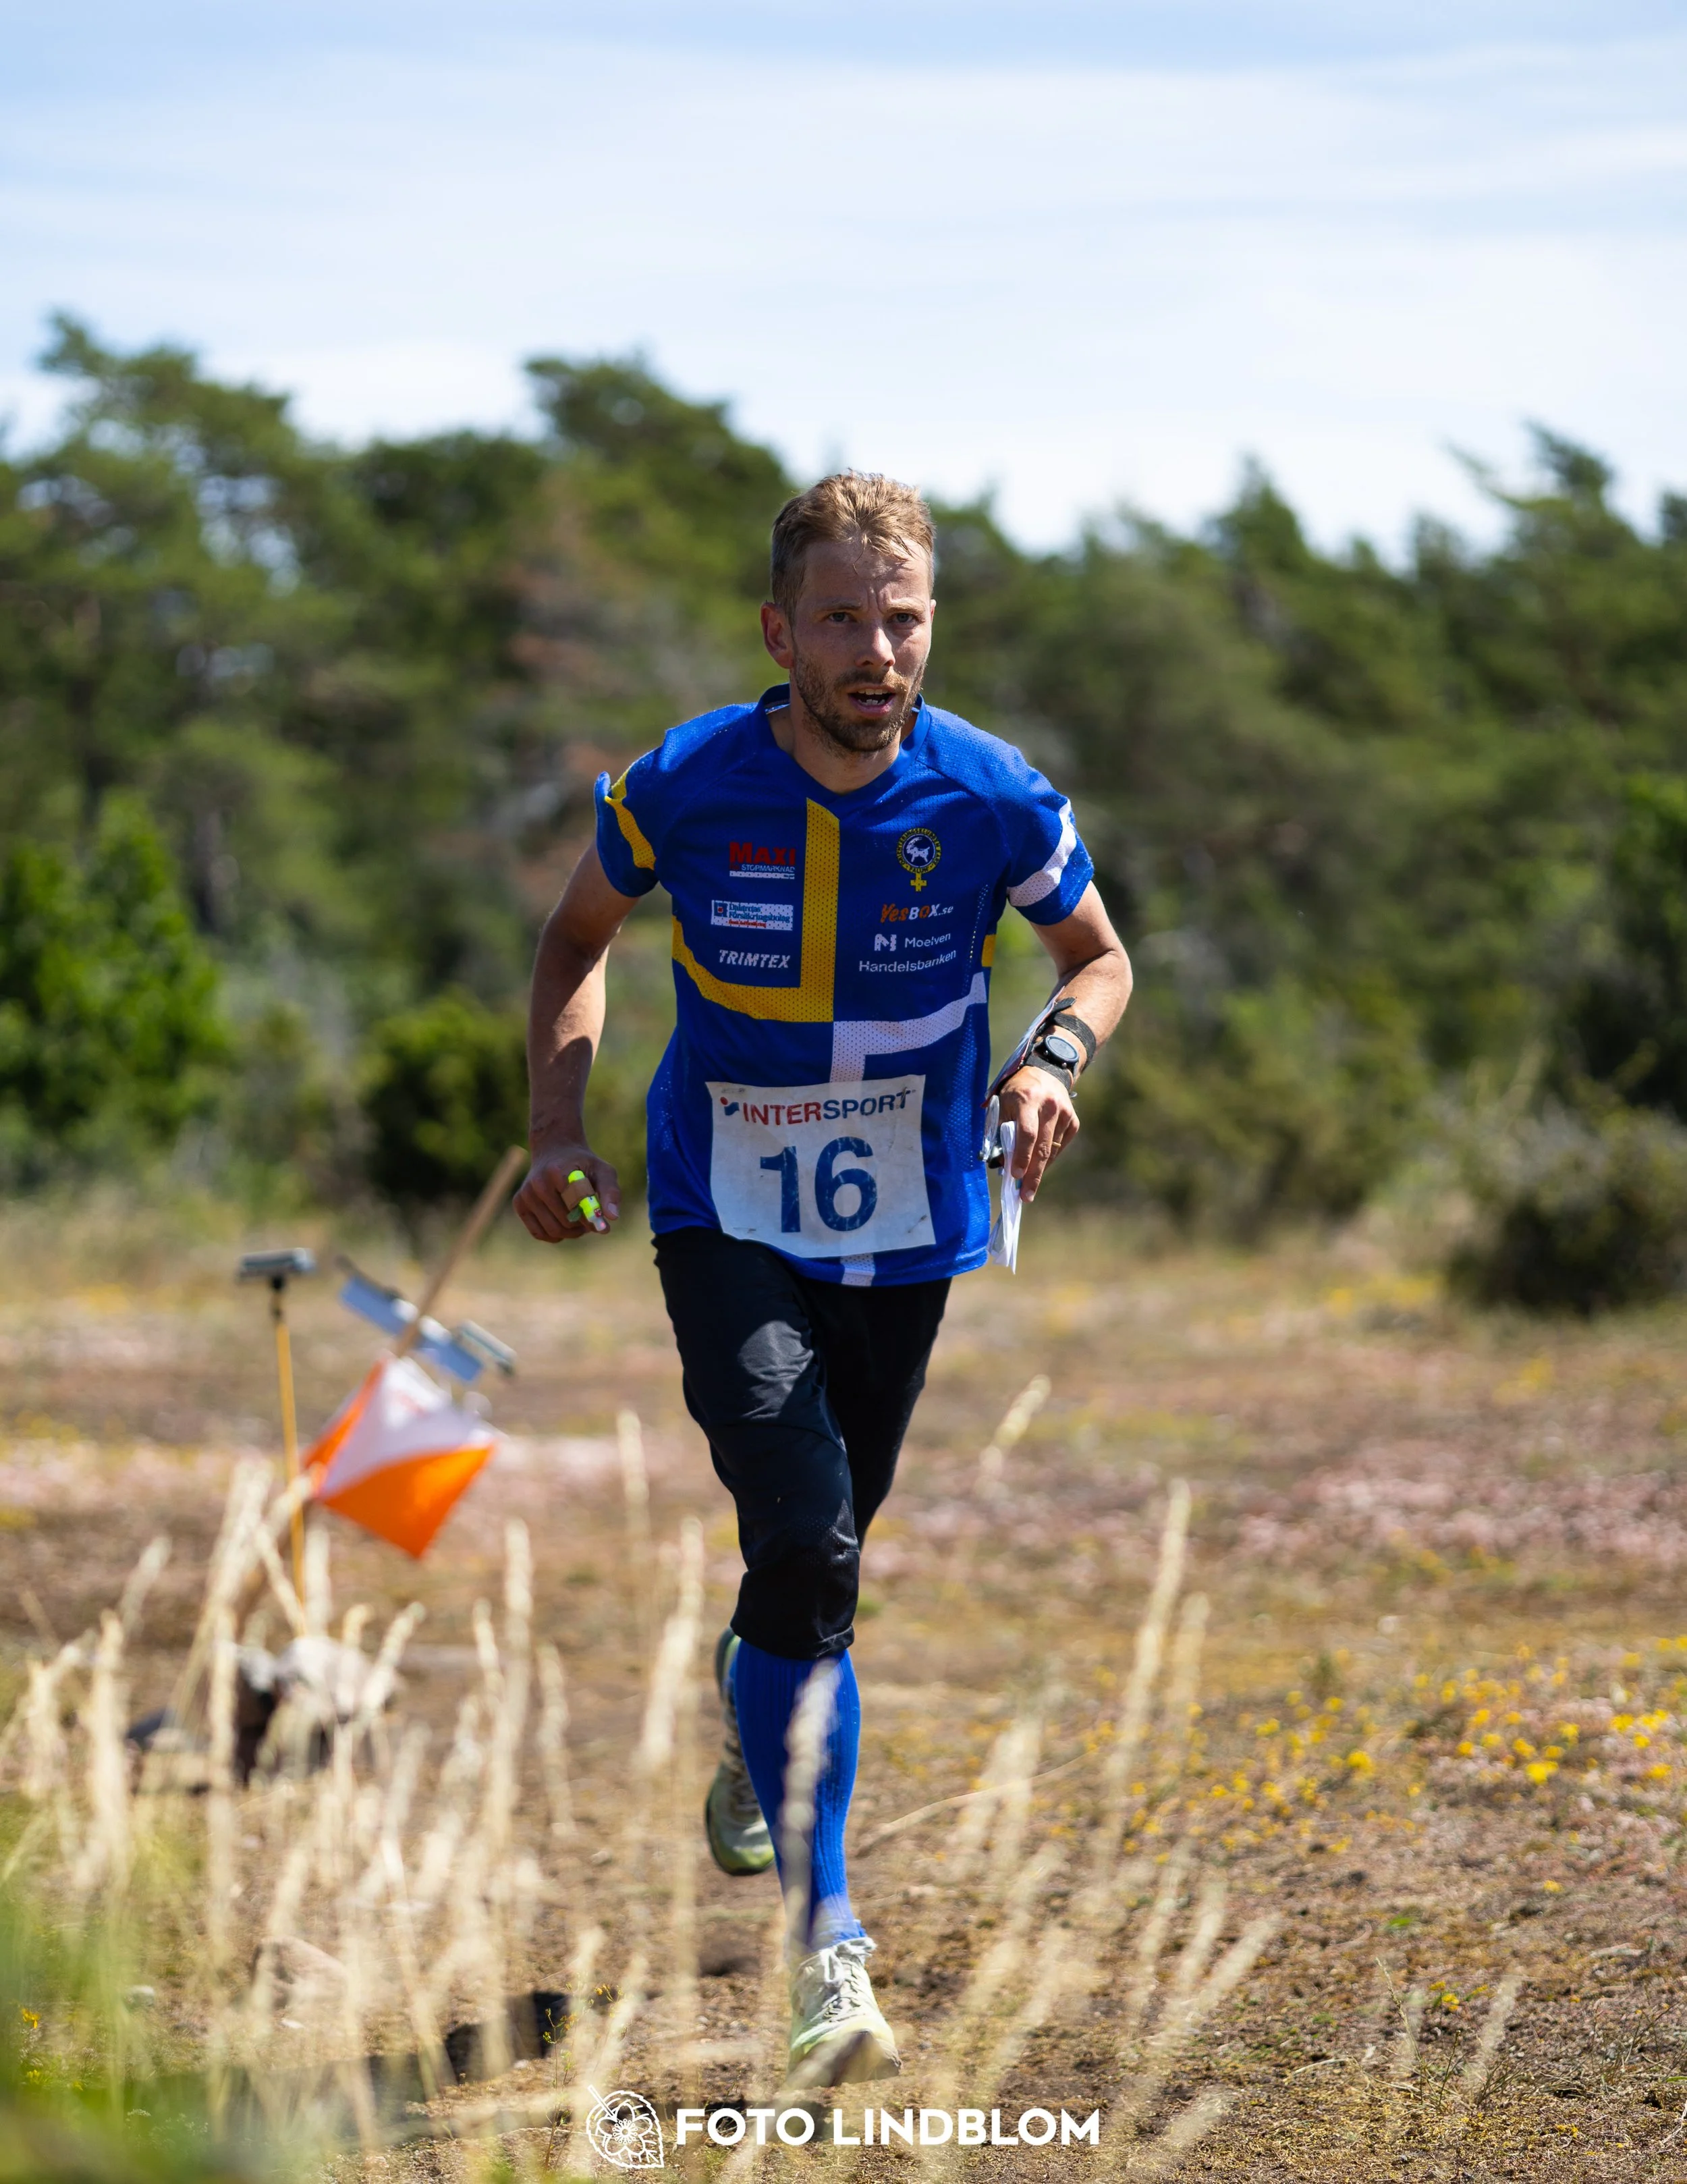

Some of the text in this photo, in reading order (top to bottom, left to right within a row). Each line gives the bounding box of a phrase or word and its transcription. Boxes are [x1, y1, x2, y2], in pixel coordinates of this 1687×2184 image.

[729, 842, 796, 865] MAXI
[905, 933, 951, 948] Moelven
[719, 950, 790, 968] TRIMTEX
[859, 950, 956, 972] Handelsbanken
[743, 1089, 910, 1126] INTERSPORT
[760, 1136, 878, 1233] 16
